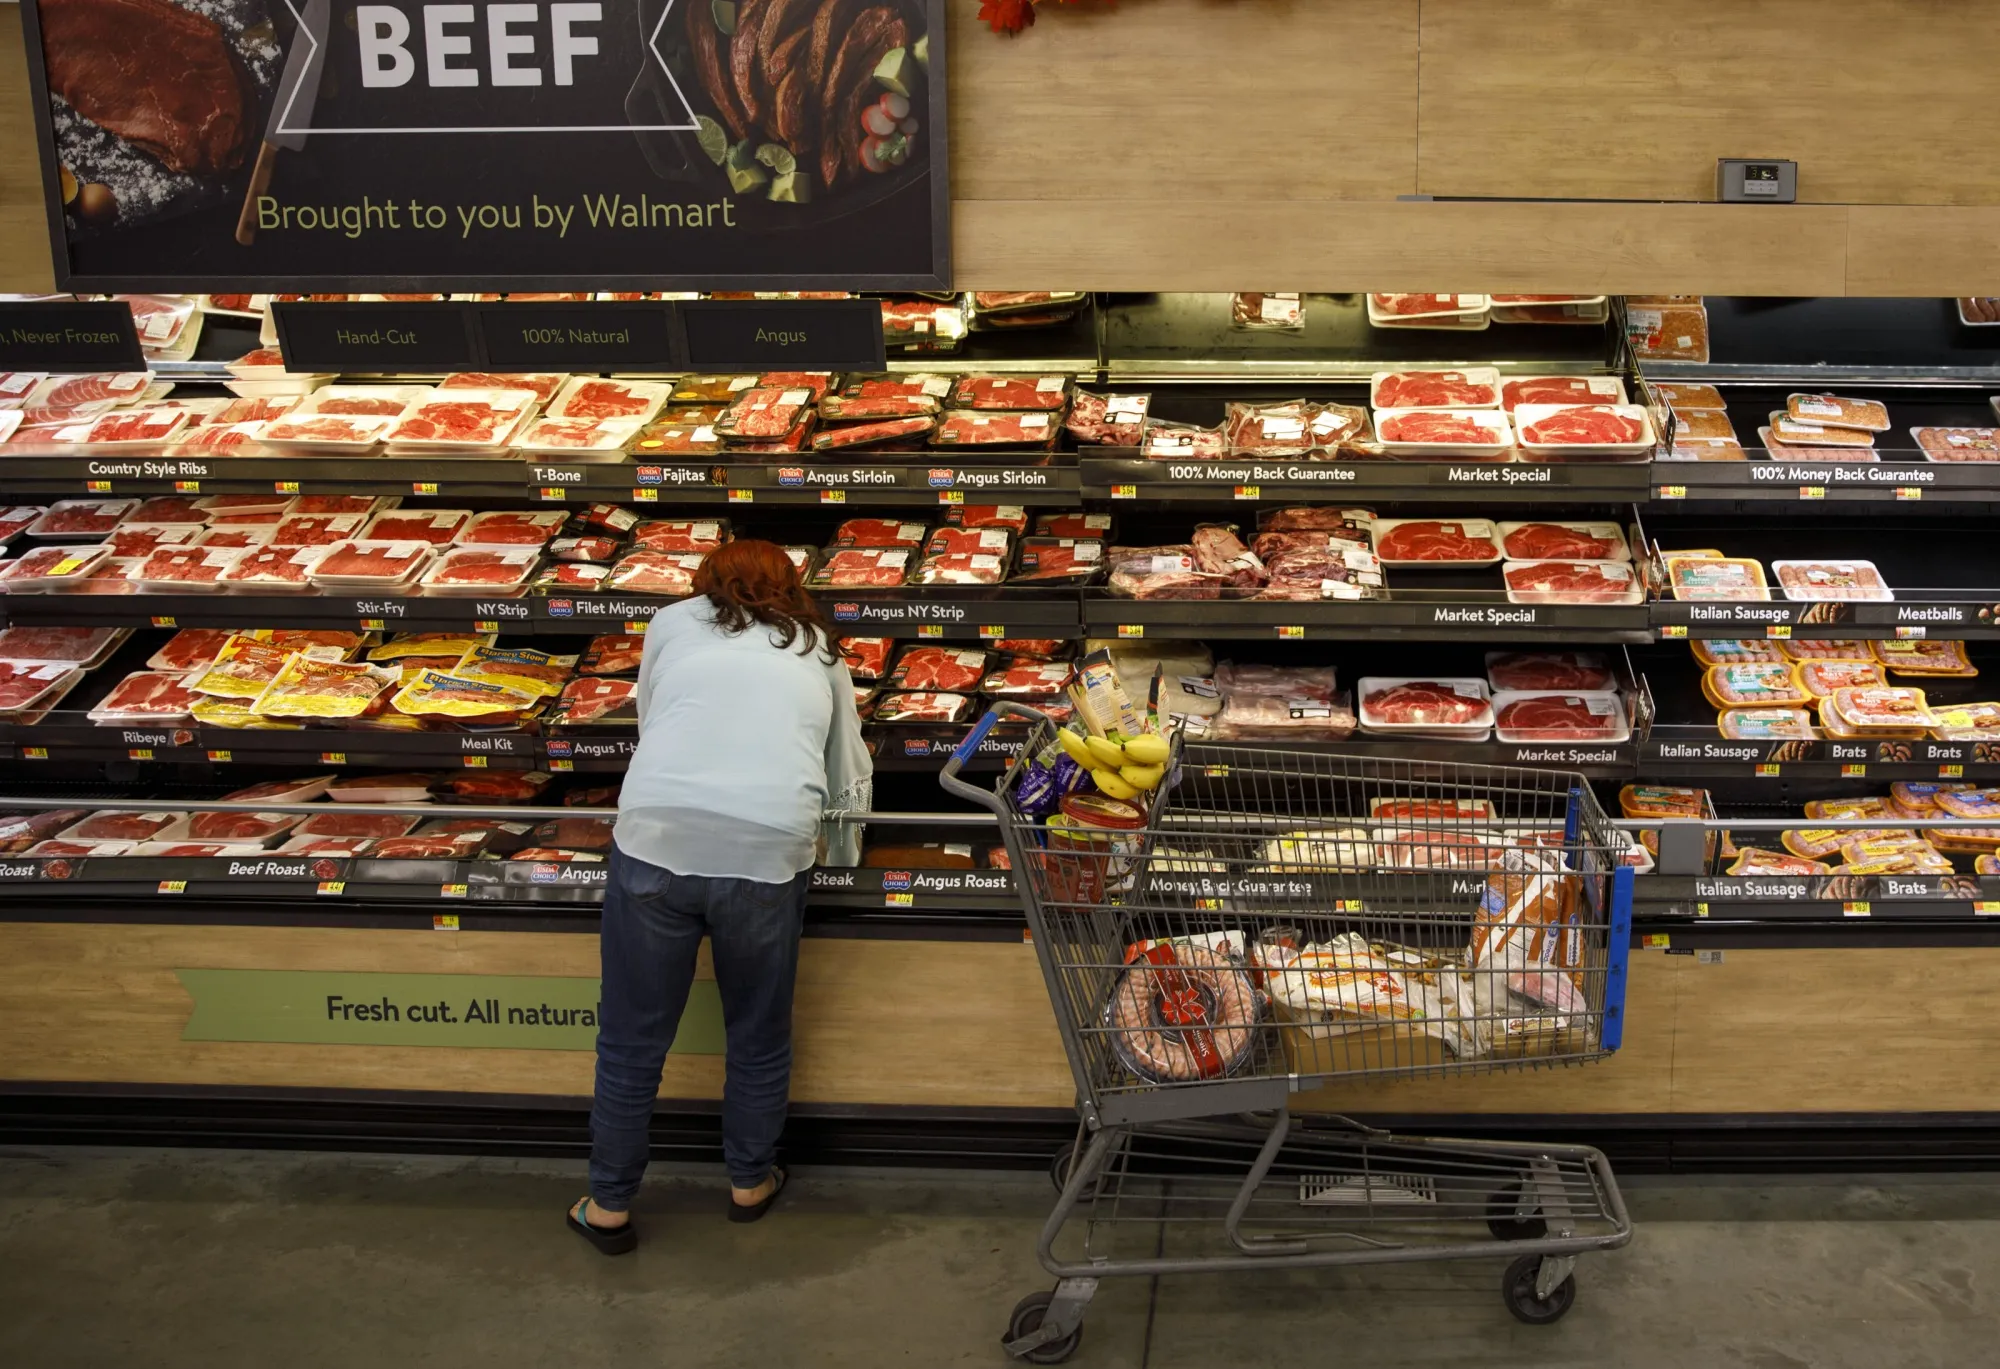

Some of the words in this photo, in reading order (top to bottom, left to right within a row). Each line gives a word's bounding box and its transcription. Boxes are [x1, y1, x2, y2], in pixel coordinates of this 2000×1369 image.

[359, 3, 603, 88] BEEF
[258, 195, 400, 239] Brought
[409, 201, 447, 229] to
[457, 204, 522, 239] you
[534, 195, 574, 239] by
[584, 194, 736, 229] Walmart
[12, 329, 61, 344] Never
[65, 328, 119, 344] Frozen
[336, 327, 418, 345] Hand-Cut
[521, 327, 565, 345] 100%
[569, 327, 629, 345] Natural
[755, 327, 806, 350] Angus
[89, 461, 142, 478] Country
[145, 462, 177, 478] Style
[180, 462, 207, 476] Ribs
[534, 468, 581, 483] T-Bone
[641, 466, 660, 474] USDA
[663, 468, 706, 485] Fajitas
[782, 468, 801, 476] USDA
[932, 469, 952, 477] USDA
[1169, 466, 1204, 480] 100%
[1206, 467, 1251, 483] Money
[1254, 467, 1285, 481] Back
[1287, 467, 1356, 481] Guarantee
[1448, 467, 1499, 482] Market
[1502, 468, 1551, 484] Special
[1752, 466, 1786, 480] 100%
[1788, 468, 1832, 484] Money
[1835, 468, 1865, 481] Back
[1868, 469, 1934, 482] Guarantee
[807, 470, 849, 487] Angus
[852, 470, 896, 485] Sirloin
[956, 471, 999, 489] Angus
[1002, 471, 1046, 486] Sirloin
[357, 602, 405, 617] Stir-Fry
[477, 603, 496, 616] NY
[498, 604, 528, 619] Strip
[577, 602, 606, 615] Filet
[609, 603, 659, 620] Mignon
[862, 605, 904, 622] Angus
[907, 605, 929, 618] NY
[932, 605, 965, 622] Strip
[1434, 608, 1484, 622] Market
[1487, 608, 1536, 625] Special
[1690, 606, 1731, 620] Italian
[1734, 607, 1790, 624] Sausage
[1898, 607, 1963, 621] Meatballs
[123, 731, 167, 747] Ribeye
[461, 738, 492, 750] Meal
[494, 738, 513, 751] Kit
[979, 740, 1024, 755] Ribeye
[574, 742, 616, 757] Angus
[1516, 750, 1565, 762] Market
[1568, 750, 1616, 764] Special
[1660, 744, 1701, 758] Italian
[1704, 744, 1759, 761] Sausage
[1832, 744, 1867, 759] Brats
[1927, 745, 1962, 760] Brats
[0, 864, 35, 876] Roast
[228, 862, 264, 876] Beef
[266, 862, 306, 876] Roast
[561, 866, 608, 883] Angus
[813, 872, 854, 887] Steak
[913, 873, 961, 891] Angus
[965, 874, 1007, 889] Roast
[1696, 882, 1742, 896] Italian
[1745, 883, 1806, 899] Sausage
[1888, 881, 1927, 896] Brats
[327, 996, 399, 1022] Fresh
[406, 999, 458, 1024] cut.
[464, 999, 499, 1025] All
[508, 1001, 601, 1028] natural
